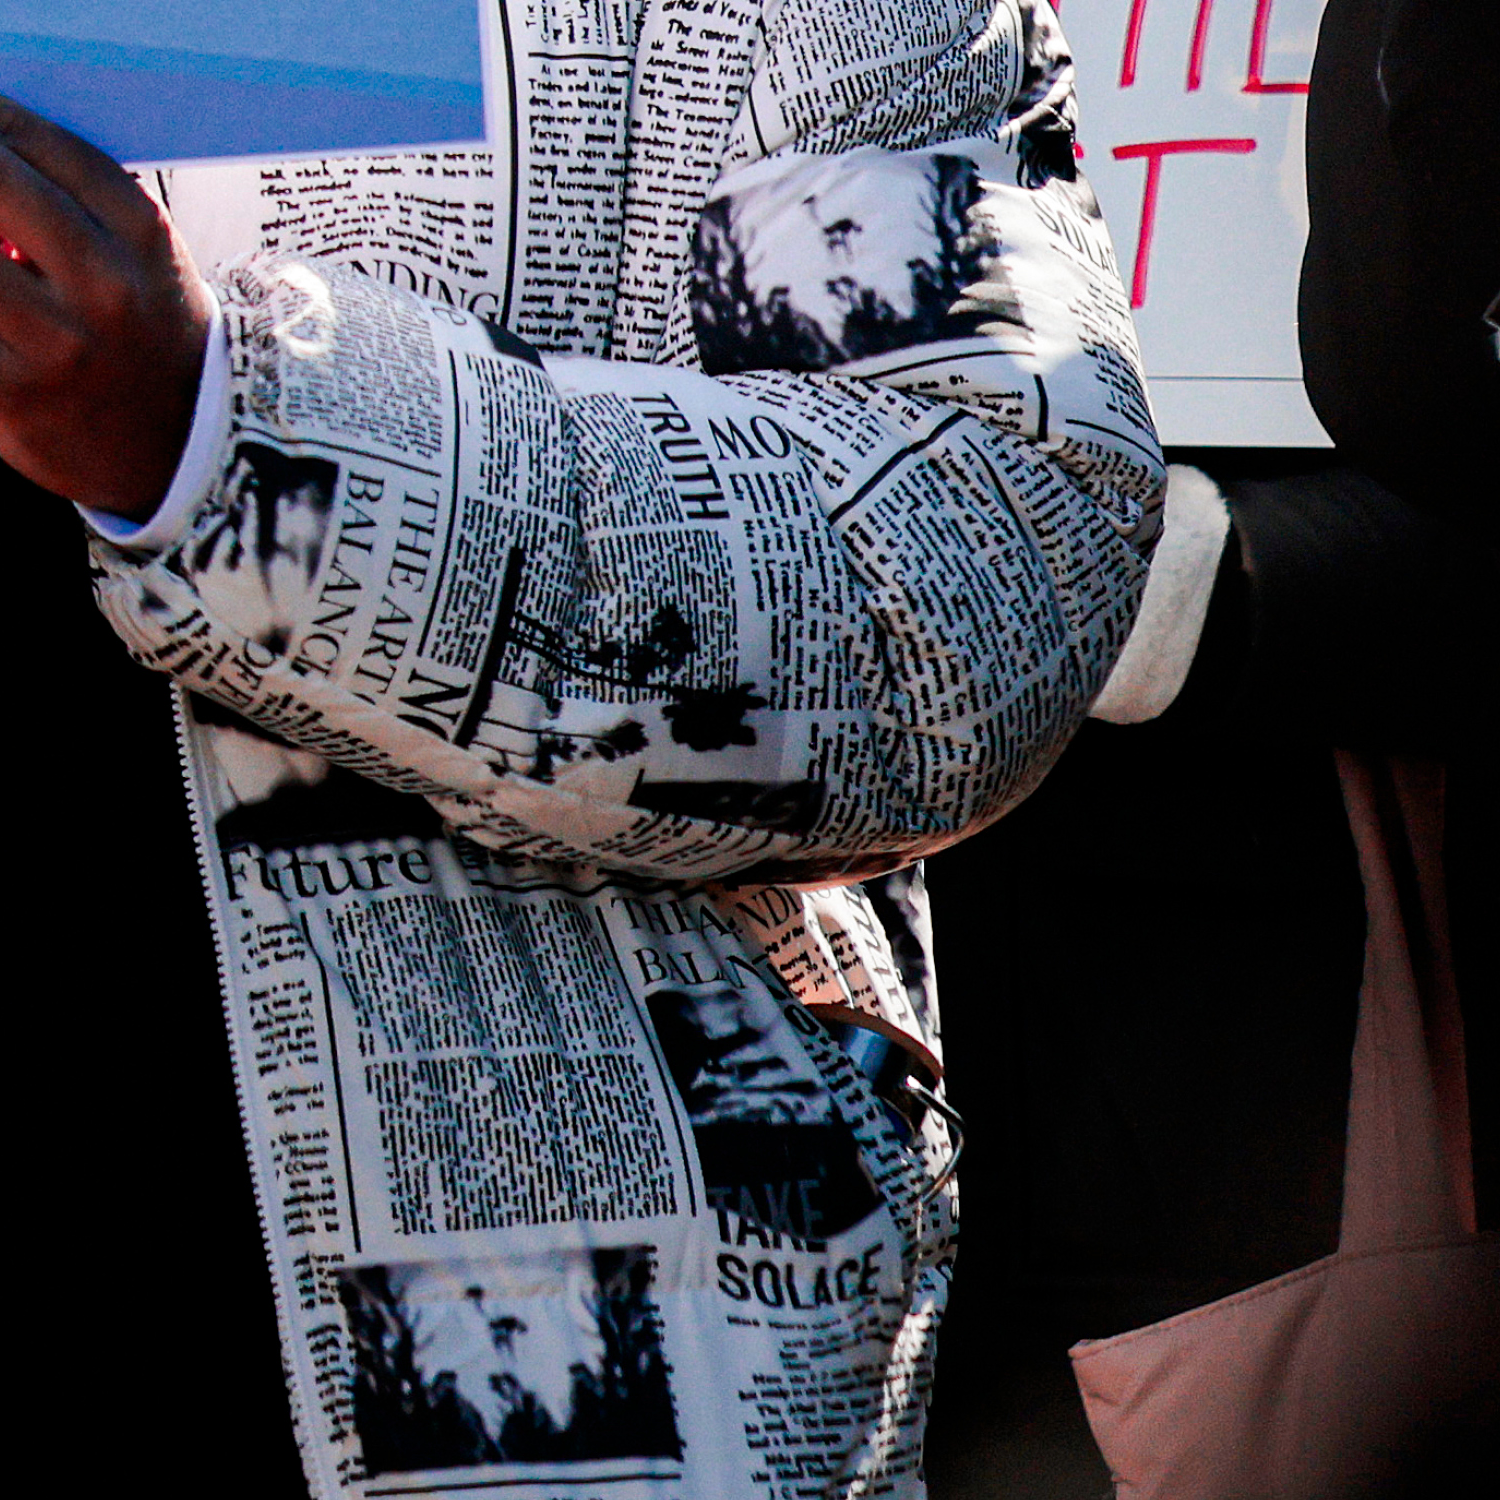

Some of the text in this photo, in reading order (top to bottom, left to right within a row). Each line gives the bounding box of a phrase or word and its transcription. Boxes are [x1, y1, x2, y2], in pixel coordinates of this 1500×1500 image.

[631, 392, 730, 520] TRUTH
[356, 490, 440, 694] THE ART
[221, 845, 433, 902] Future
[716, 1243, 884, 1310] SOLACE
